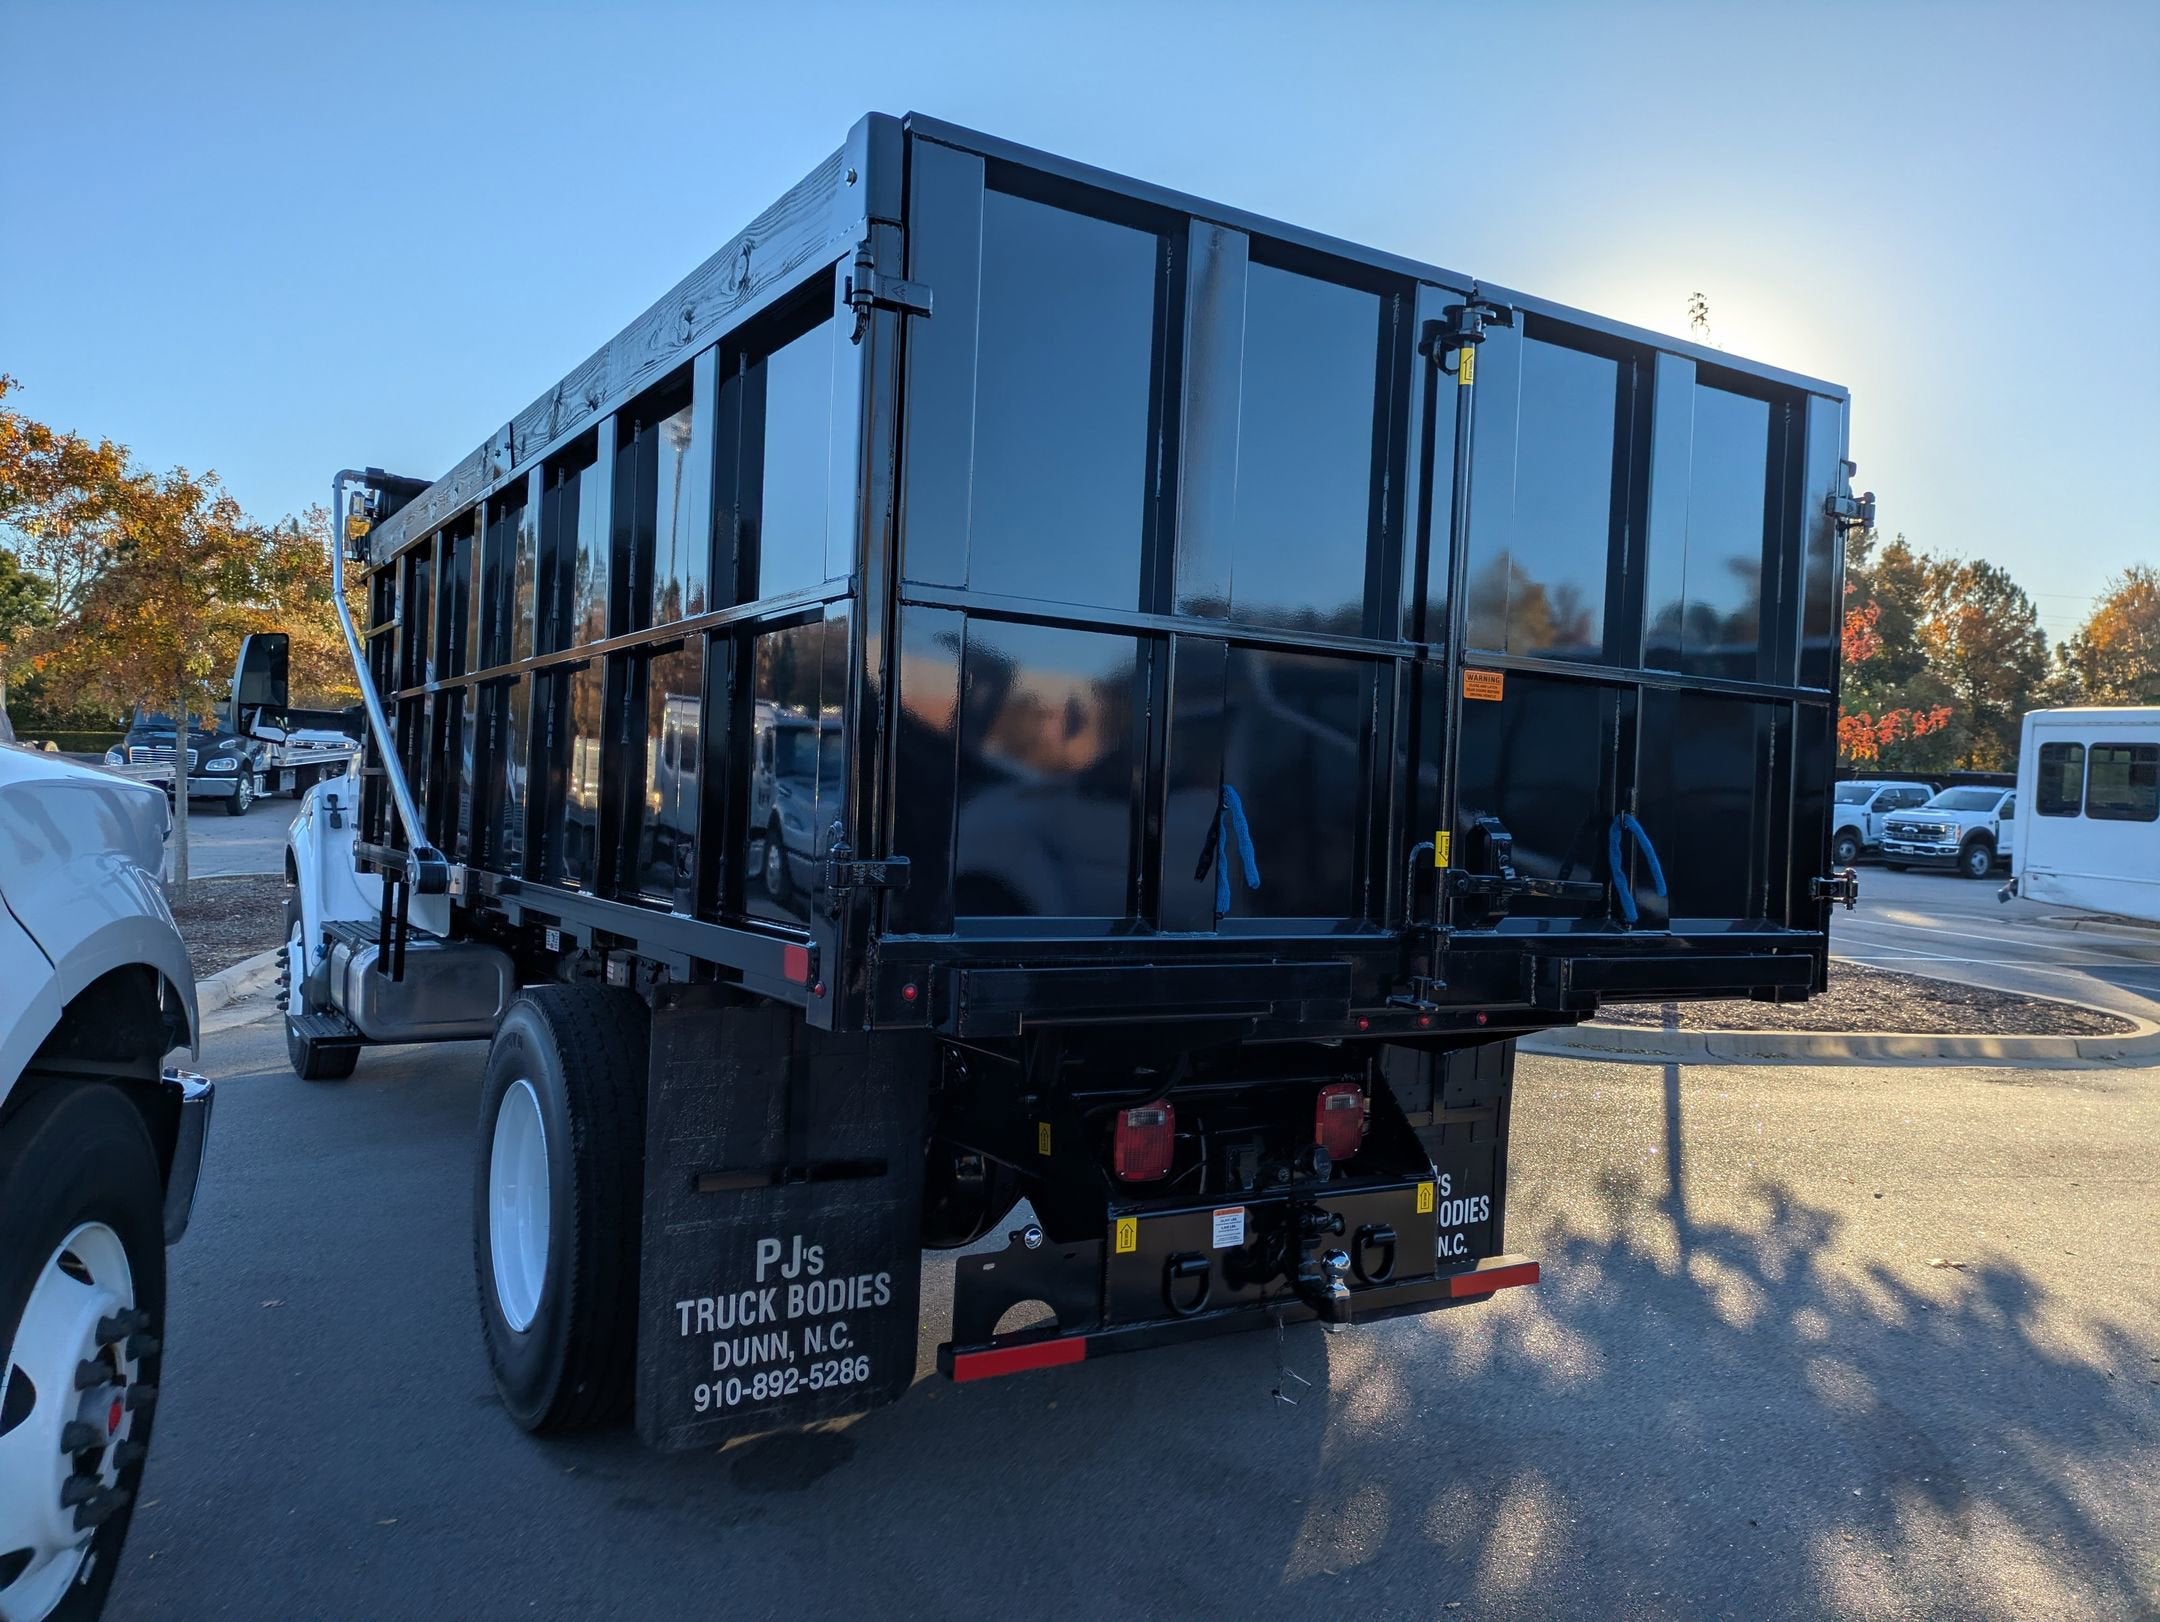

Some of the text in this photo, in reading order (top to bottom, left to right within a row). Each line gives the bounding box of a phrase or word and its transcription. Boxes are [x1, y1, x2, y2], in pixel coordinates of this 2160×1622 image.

[1467, 674, 1500, 683] WARNING
[1440, 1195, 1489, 1227] ODIES
[1438, 1233, 1468, 1258] N.C.
[676, 1272, 891, 1337] TRUCK BODIES
[713, 1321, 854, 1371] DUNN, N.C.
[694, 1355, 870, 1412] 910-892-5286
